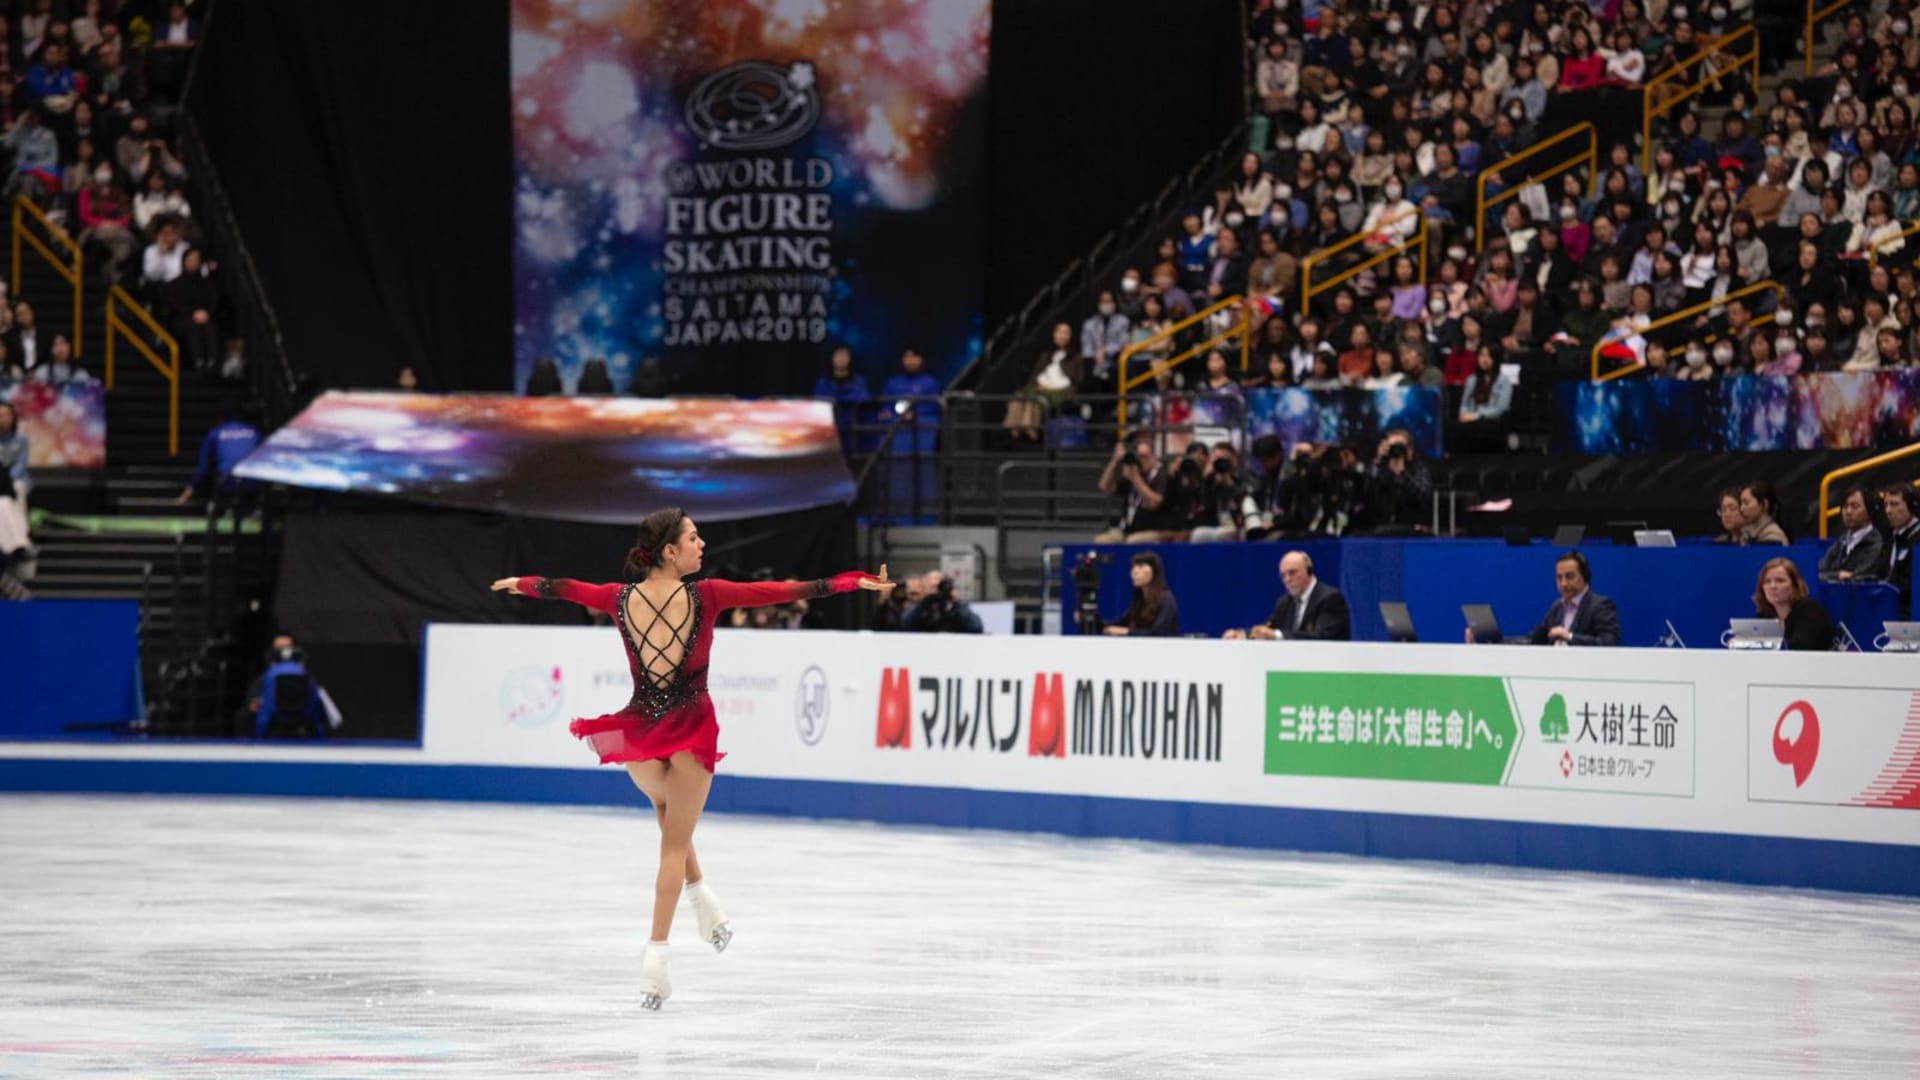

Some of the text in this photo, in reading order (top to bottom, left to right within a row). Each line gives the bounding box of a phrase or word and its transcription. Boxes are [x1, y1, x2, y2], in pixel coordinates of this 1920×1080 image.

[696, 159, 833, 189] WORLD
[667, 193, 832, 234] FIGURE
[663, 236, 831, 273] SKATING
[664, 293, 828, 322] SAITAMA
[919, 677, 1022, 752] マルハン
[1072, 679, 1223, 762] MARUHAN
[1279, 705, 1503, 750] 三井生命は「大樹生命」へ。
[1576, 701, 1678, 749] 大樹生命
